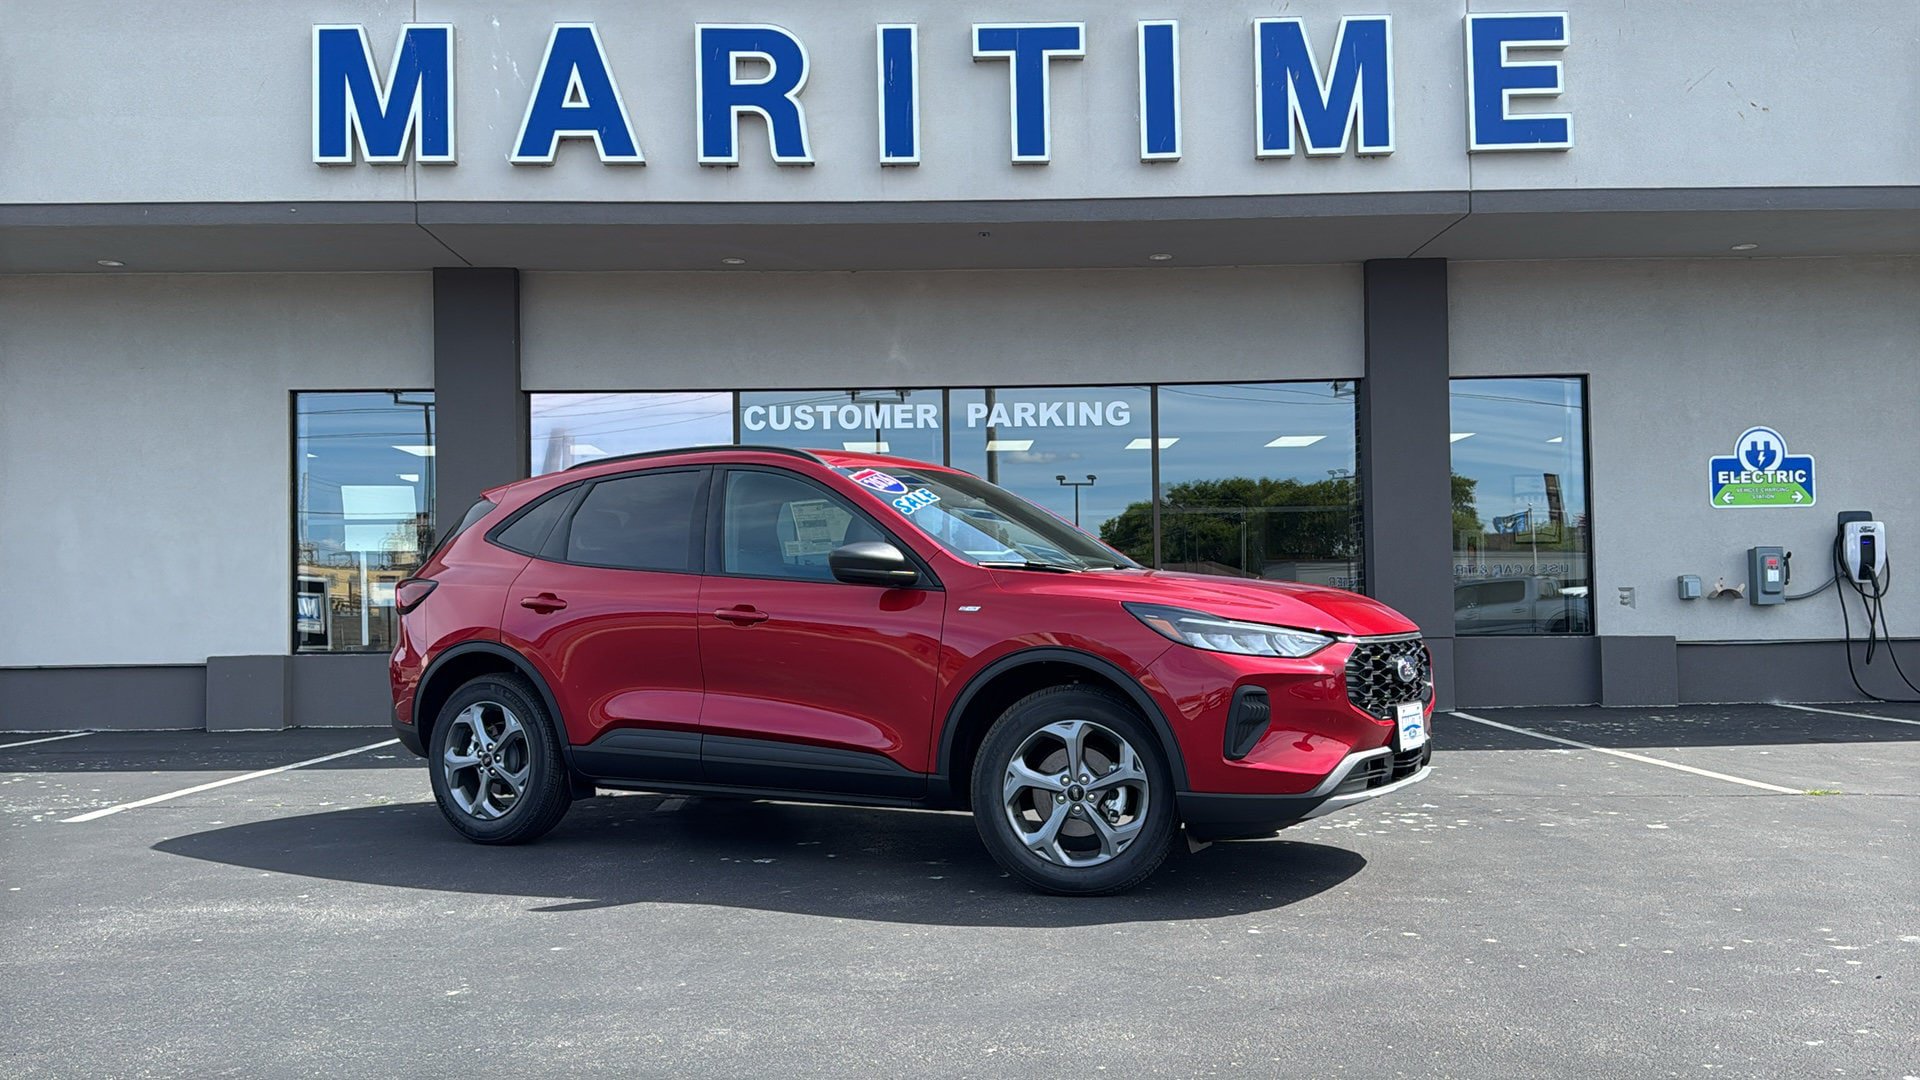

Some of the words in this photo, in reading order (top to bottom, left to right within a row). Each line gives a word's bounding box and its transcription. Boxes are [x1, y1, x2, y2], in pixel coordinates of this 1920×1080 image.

[312, 12, 1574, 165] MARITIME
[743, 404, 939, 431] CUSTOMER
[967, 401, 1130, 428] PARKING
[1718, 470, 1807, 484] ELECTRIC
[894, 488, 941, 514] SALE
